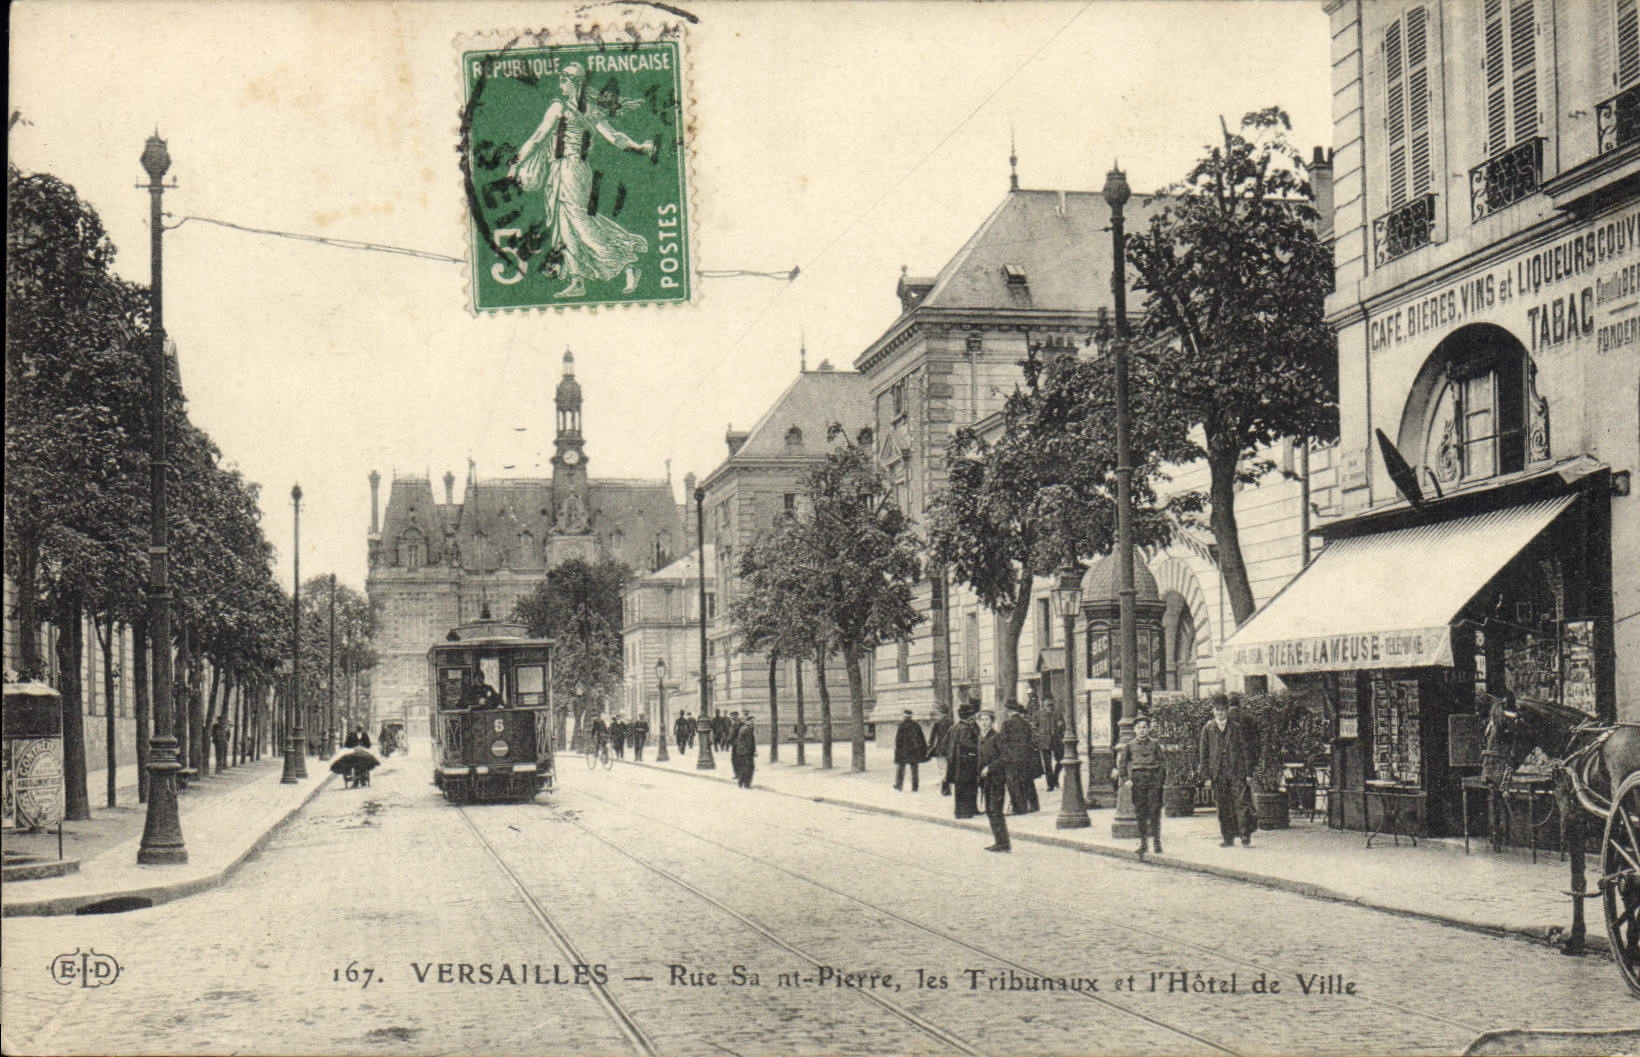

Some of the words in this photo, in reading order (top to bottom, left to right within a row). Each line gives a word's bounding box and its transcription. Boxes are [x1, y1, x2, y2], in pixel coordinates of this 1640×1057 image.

[588, 53, 670, 74] FRANÇAISE
[657, 203, 679, 288] POSTES
[1461, 274, 1495, 316] VINS
[1499, 269, 1513, 301] et
[1518, 232, 1596, 296] LIQUEURS
[1528, 287, 1594, 351] TABAC
[1331, 634, 1380, 662] MEUSE
